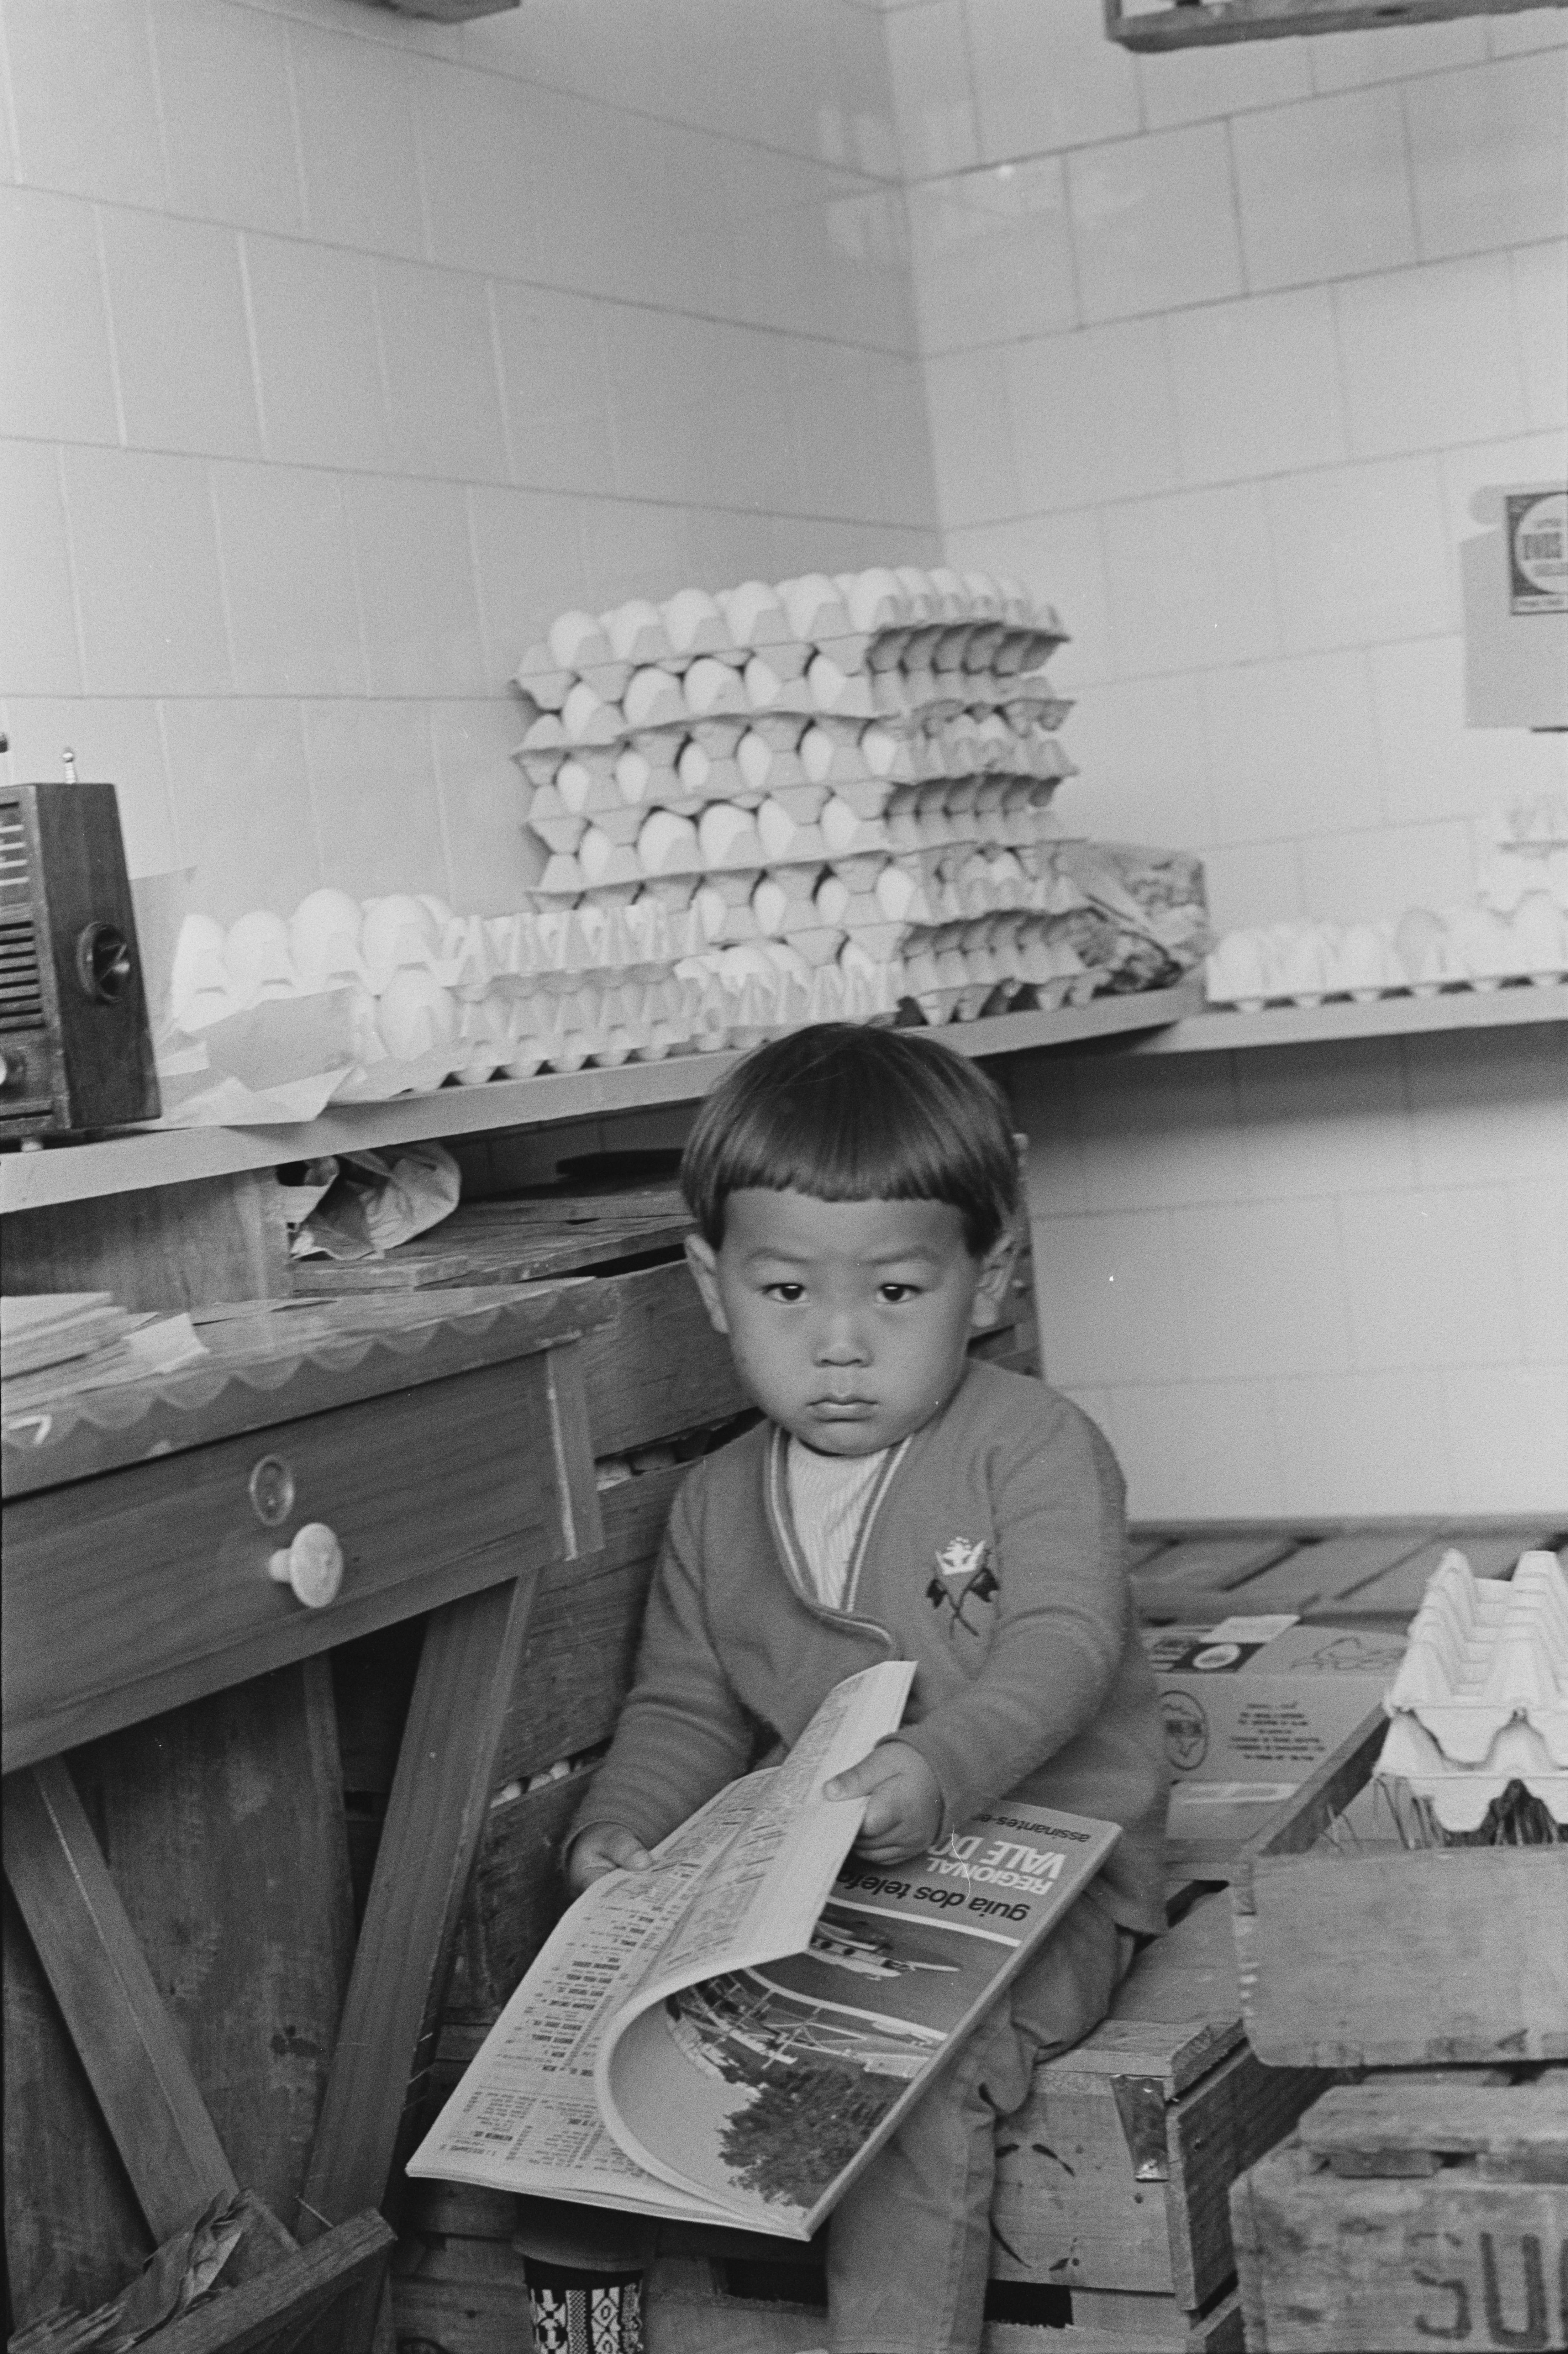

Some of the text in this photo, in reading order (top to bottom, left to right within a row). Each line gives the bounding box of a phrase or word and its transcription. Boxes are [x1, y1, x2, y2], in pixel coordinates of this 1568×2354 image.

[926, 1857, 1053, 1895] REGIONAL
[978, 1840, 1067, 1879] VALE
[837, 1873, 1031, 1921] guia dos telefo
[1405, 2231, 1568, 2348] SU
